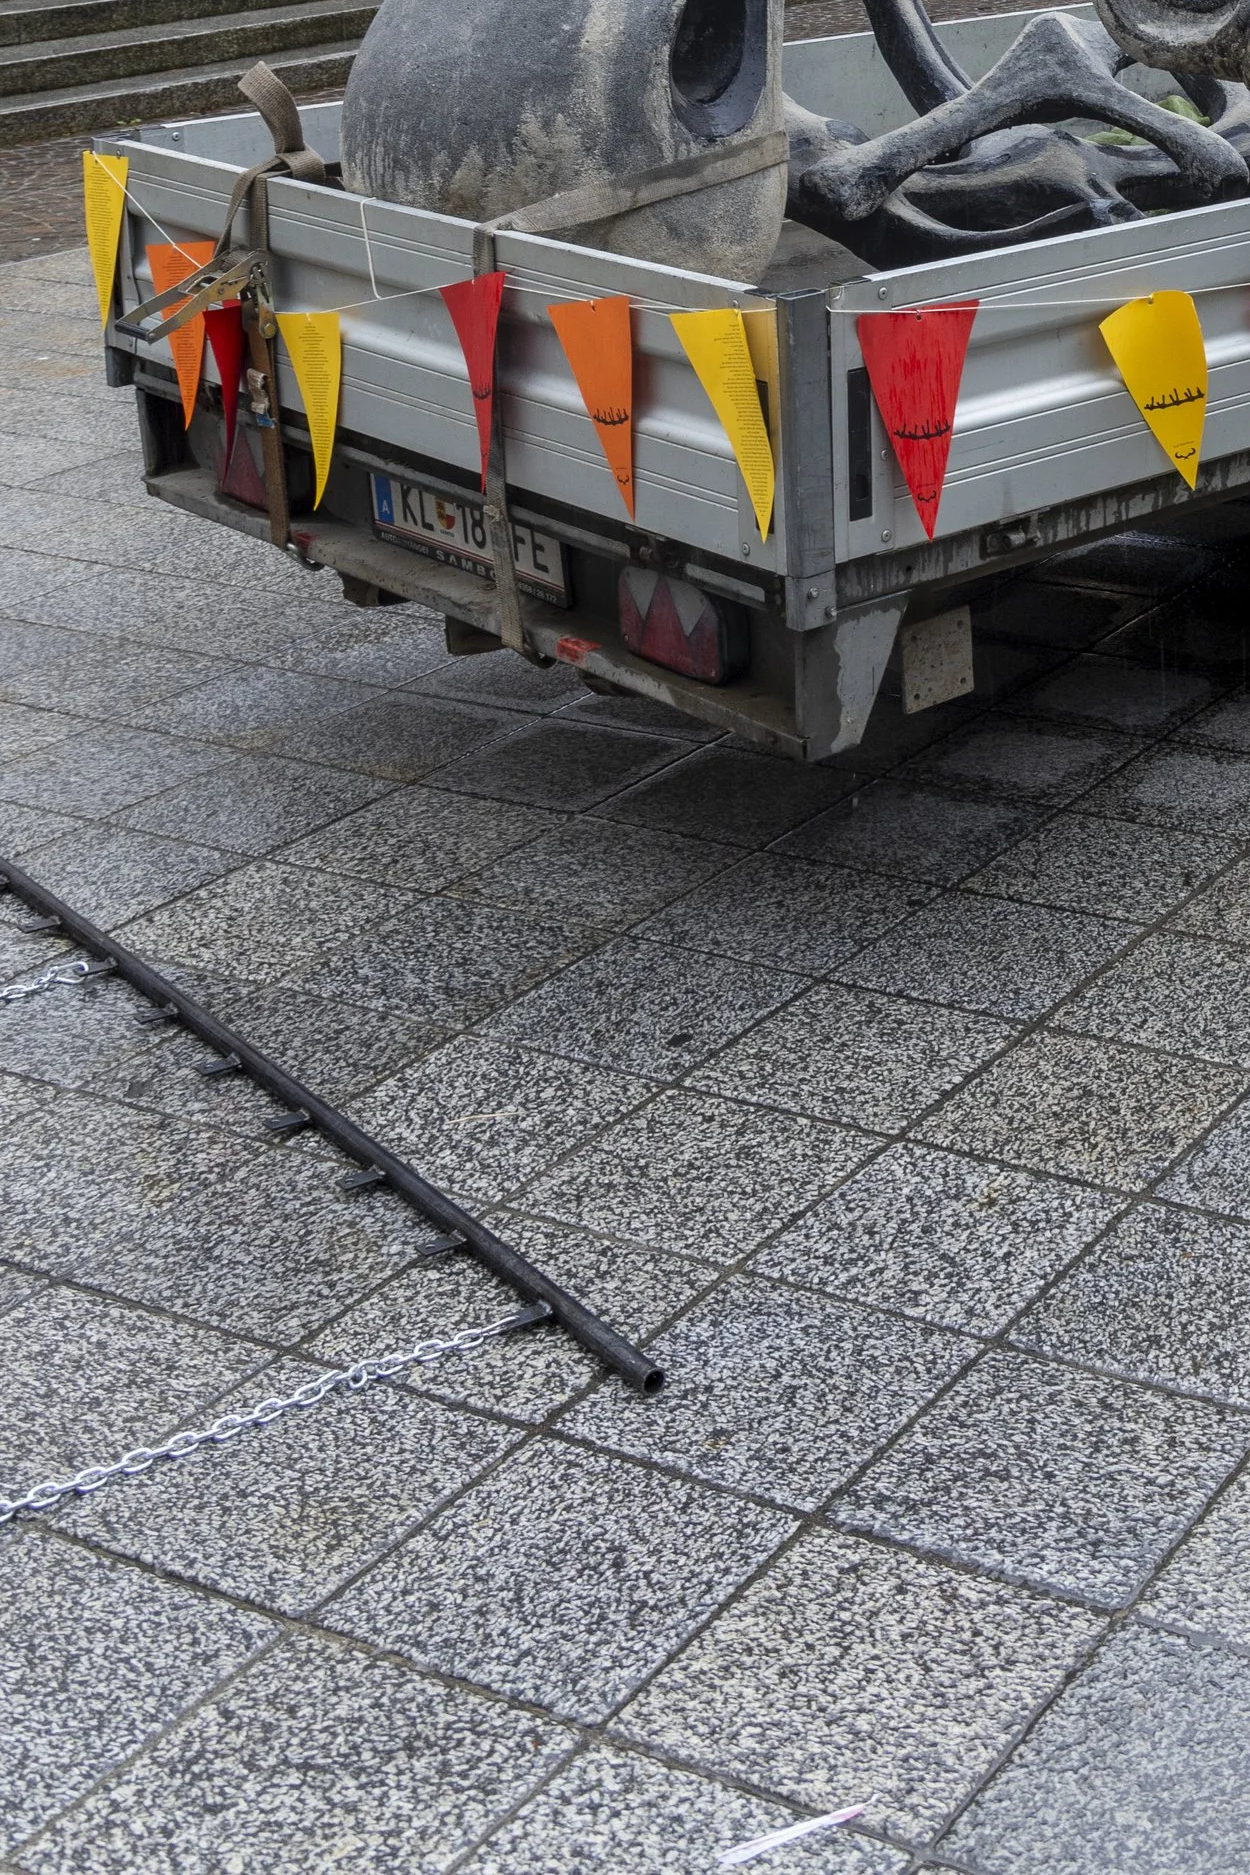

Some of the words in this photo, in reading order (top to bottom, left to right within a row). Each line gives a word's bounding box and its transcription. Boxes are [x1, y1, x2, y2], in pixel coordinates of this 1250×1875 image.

[381, 499, 391, 515] A
[401, 484, 435, 532] KL
[456, 503, 488, 549] 18
